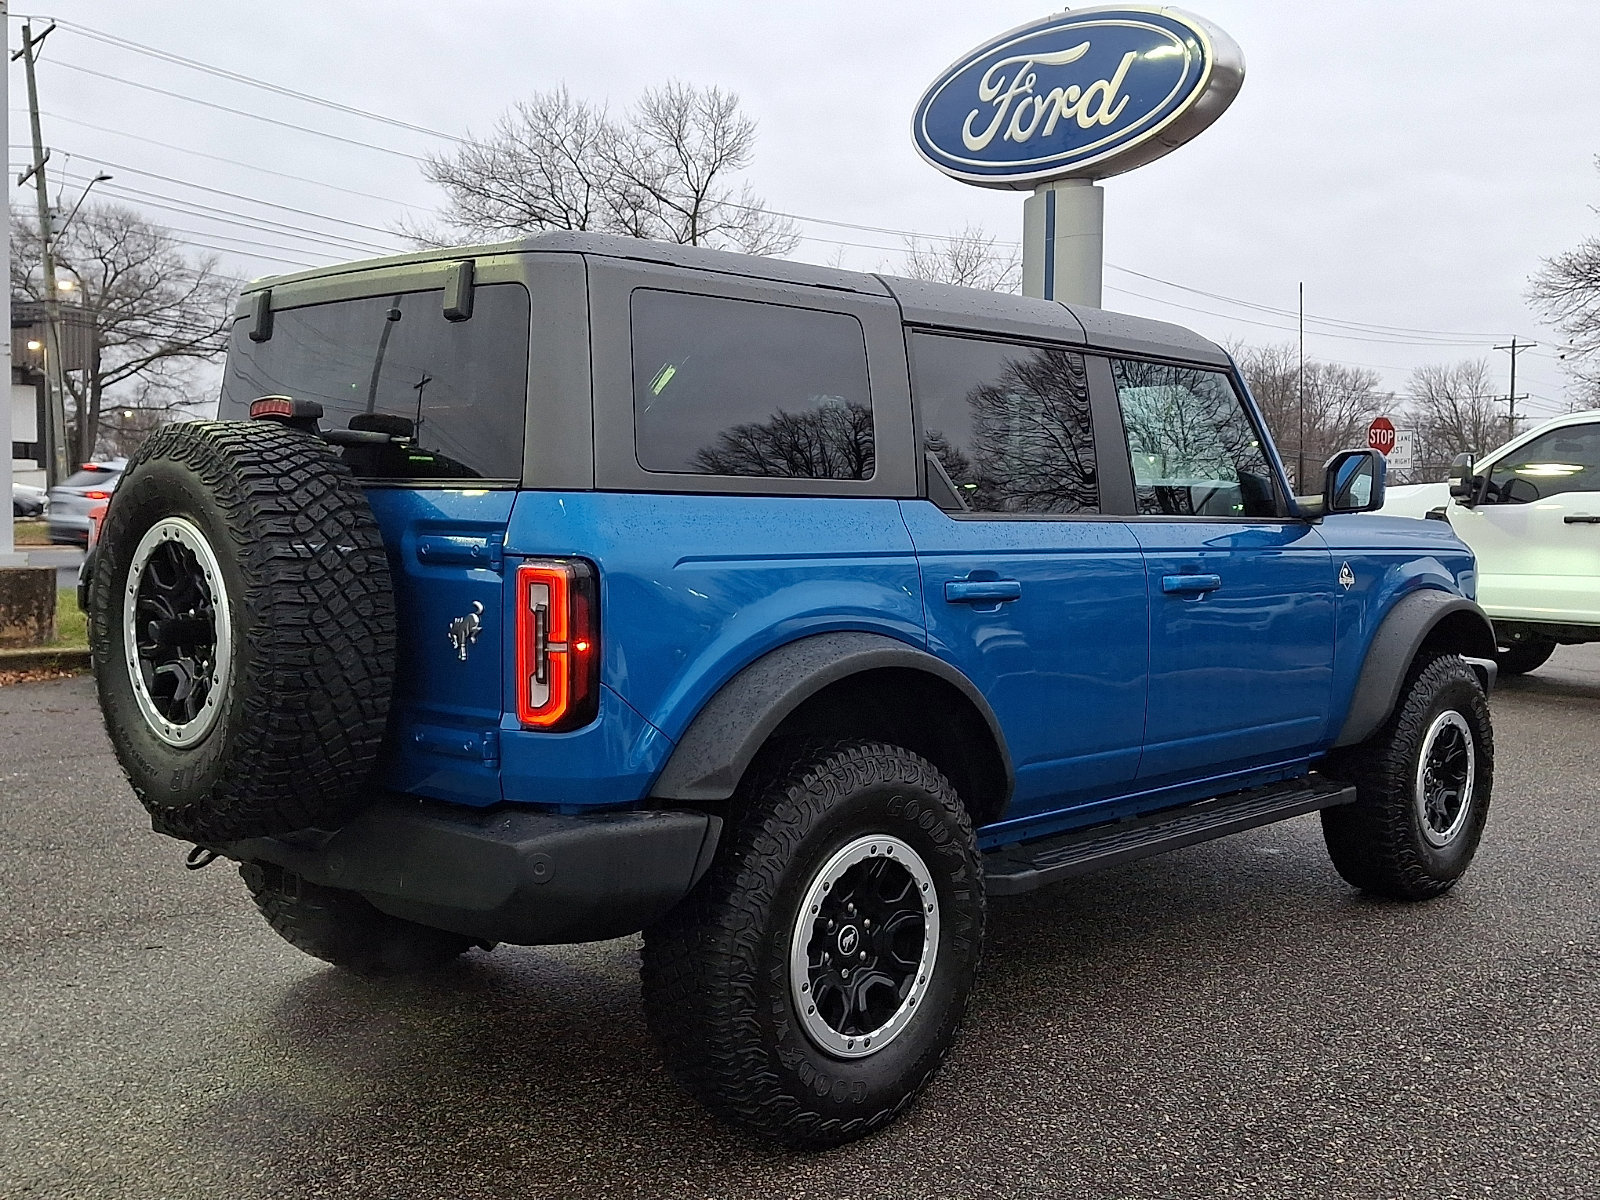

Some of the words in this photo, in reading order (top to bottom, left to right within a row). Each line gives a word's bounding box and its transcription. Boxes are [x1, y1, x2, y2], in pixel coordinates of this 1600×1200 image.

[962, 41, 1138, 152] Ford
[1369, 429, 1394, 445] STOP
[1390, 446, 1403, 454] UST
